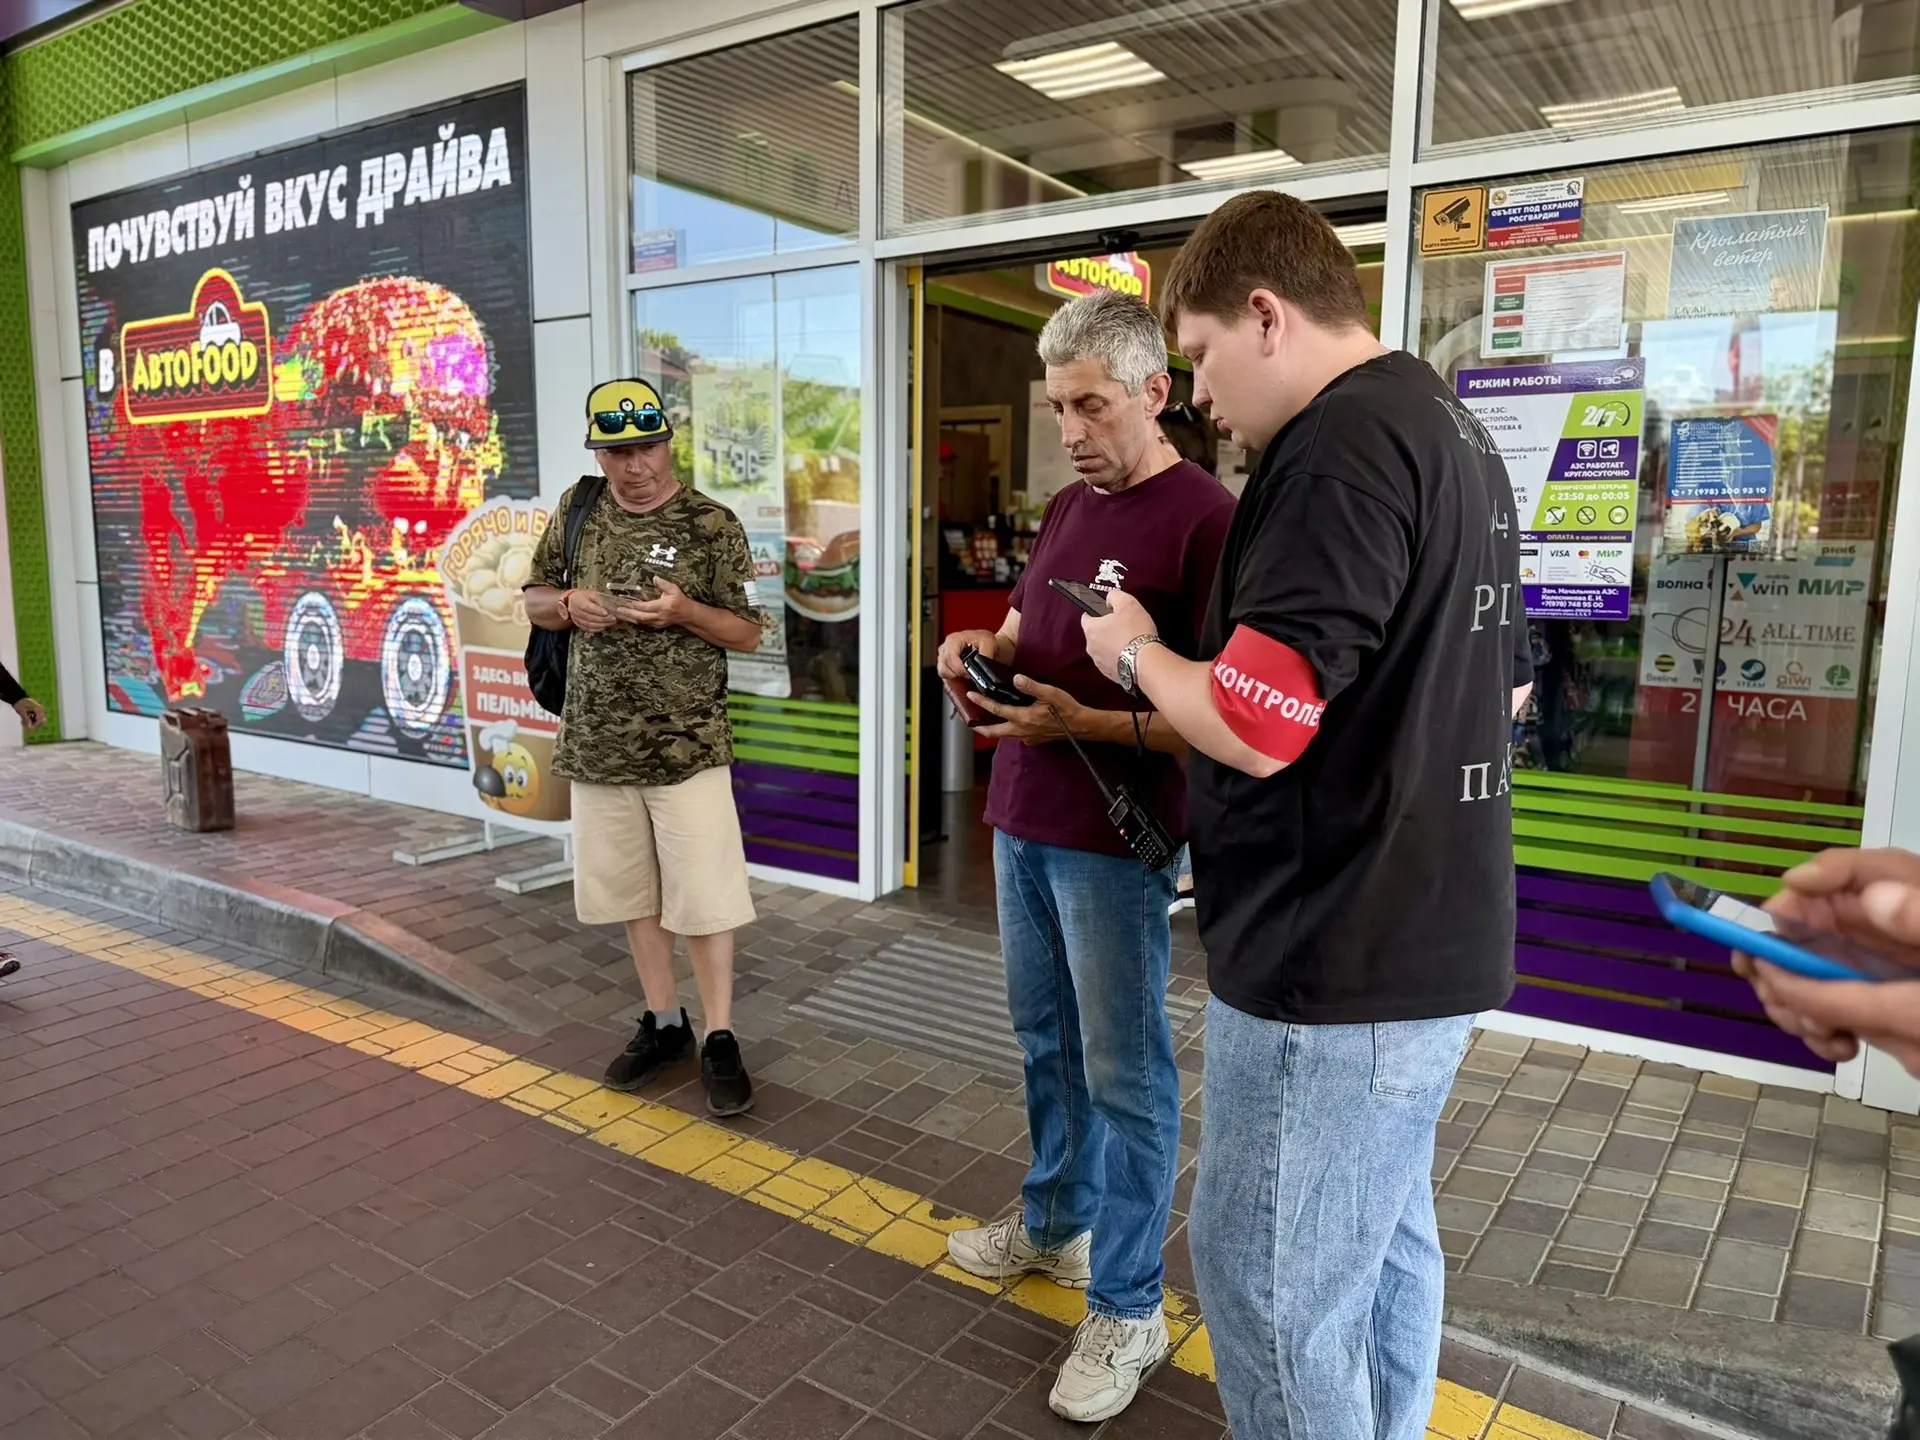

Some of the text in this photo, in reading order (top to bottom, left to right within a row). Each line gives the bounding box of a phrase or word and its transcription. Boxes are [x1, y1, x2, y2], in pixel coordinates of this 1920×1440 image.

[88, 122, 512, 272] ПОЧУВСТВУЙ ВКУС ДРАЙВА
[1491, 200, 1580, 217] ОБЪЕКТ ПОД ОХРАНОЙ
[1509, 211, 1560, 223] РОСГВАРДИИ
[1690, 218, 1808, 254] Крылатый
[1713, 247, 1774, 268] ветер
[99, 348, 114, 392] В
[1469, 375, 1622, 389] РЕЖИМ РАБОТЫ ТЭС
[1586, 461, 1625, 469] РАБОТАЕТ
[1558, 492, 1584, 500] 23:50
[1586, 493, 1599, 502] до
[1601, 491, 1630, 500] 00:05
[1695, 488, 1719, 496] (978)
[1721, 487, 1740, 495] 300
[443, 506, 511, 582] ГОРЯЧО
[1822, 545, 1857, 555] рнкб
[1550, 550, 1571, 558] VISA
[1597, 550, 1623, 558] МИР
[645, 558, 674, 568] FREEDOM
[1089, 583, 1117, 592] BURBER
[1541, 587, 1558, 595] Зам.
[1656, 579, 1704, 590] волна
[1752, 581, 1789, 596] win
[1797, 578, 1866, 596] МИР
[1720, 617, 1756, 647] 24
[1761, 622, 1801, 641] ALL
[1804, 624, 1856, 643] TIME
[473, 665, 511, 684] ЗДЕСЬ
[1646, 672, 1679, 684] Beeline
[1737, 680, 1766, 688] STEAM
[1214, 660, 1327, 727] КОНТРОЛЁ
[476, 691, 561, 724] ПЕЛЬМЕН
[1680, 691, 1808, 721] 2 ЧАСА
